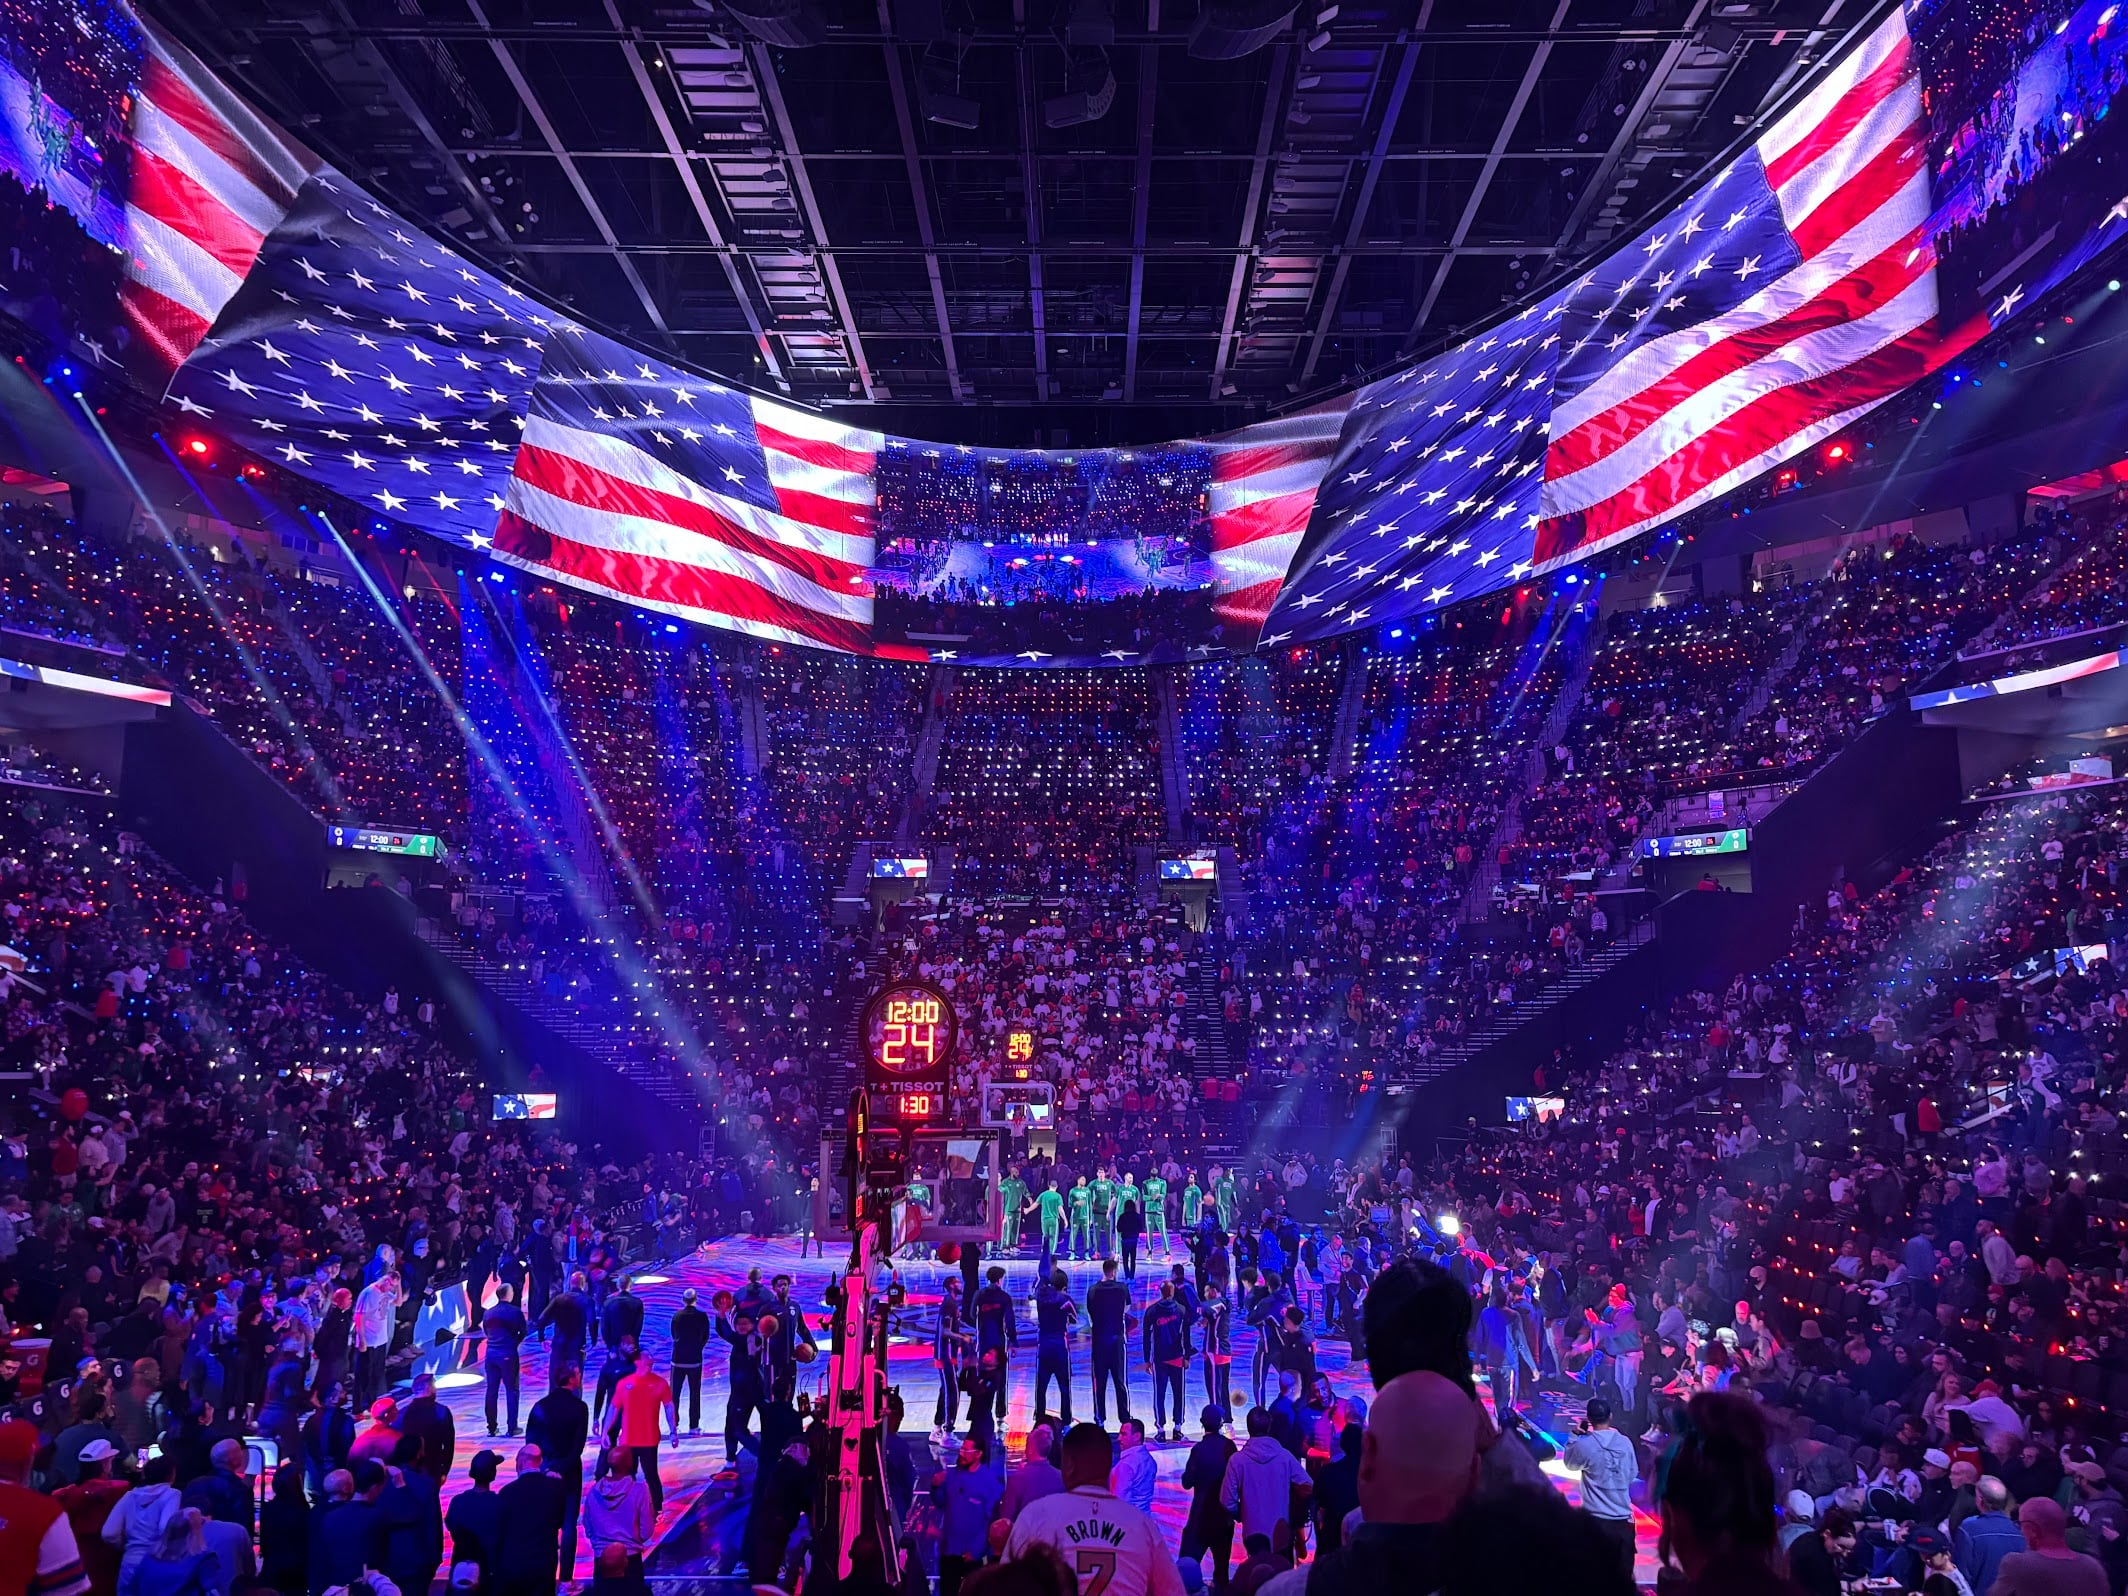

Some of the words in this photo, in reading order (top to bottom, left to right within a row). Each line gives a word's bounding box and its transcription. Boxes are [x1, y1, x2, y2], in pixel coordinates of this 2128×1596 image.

[370, 835, 388, 844] 12:00
[1684, 838, 1702, 848] 12:00
[888, 1001, 939, 1023] 12:00
[883, 1024, 934, 1064] 24
[1008, 1042, 1030, 1060] 24
[890, 1081, 945, 1092] TISSOT
[900, 1095, 930, 1114] 1:30
[27, 1354, 39, 1366] G
[113, 1364, 122, 1377] G
[60, 1384, 70, 1398] G
[33, 1400, 43, 1415] G
[1065, 1519, 1126, 1547] BROWN
[1076, 1550, 1117, 1596] 7
